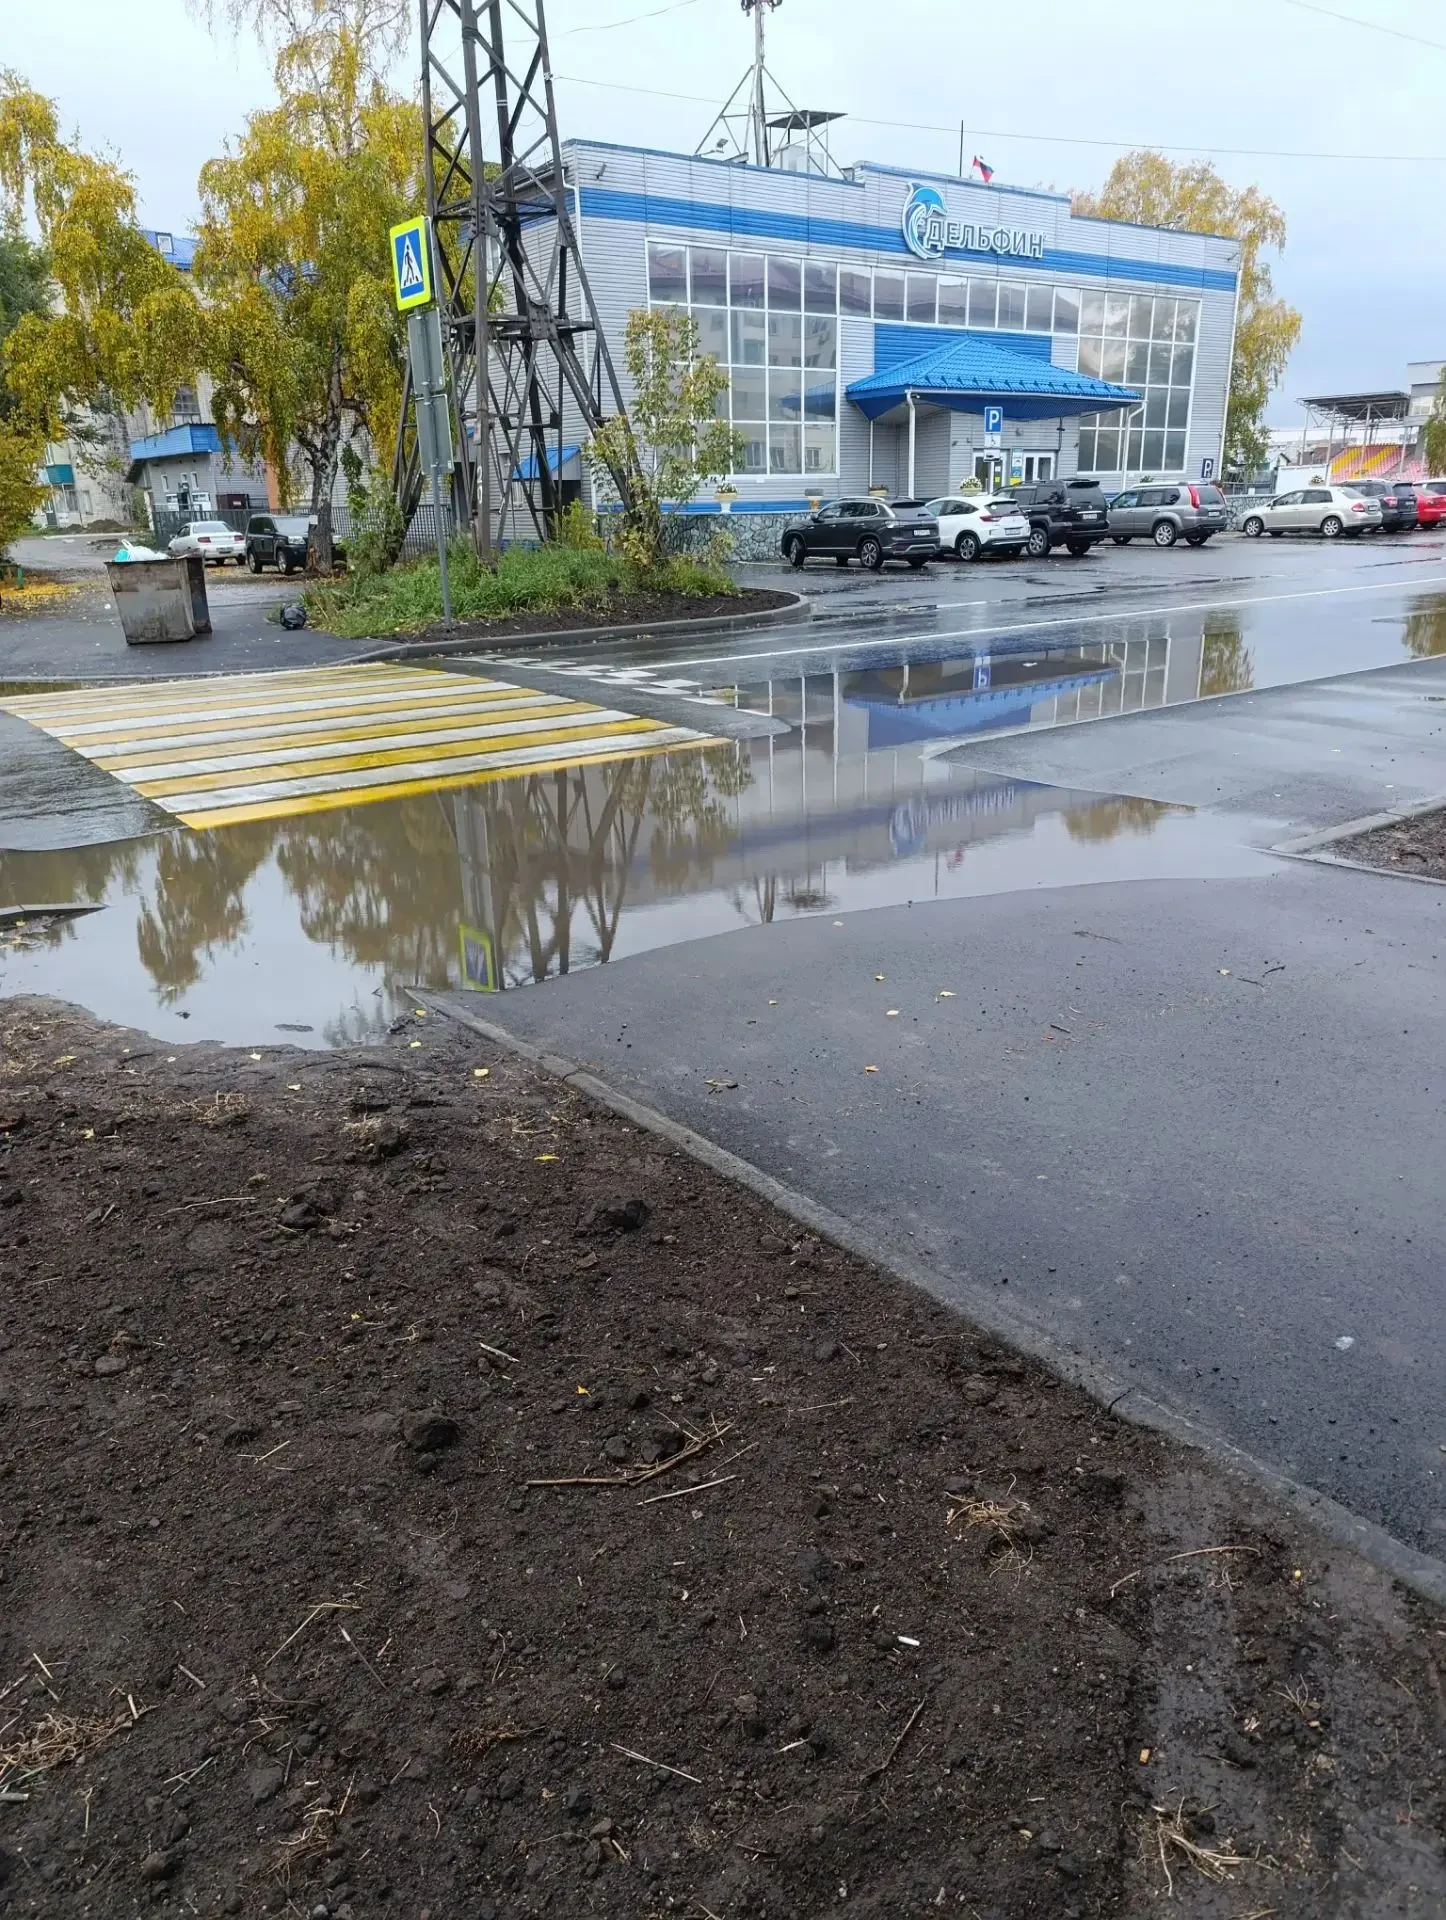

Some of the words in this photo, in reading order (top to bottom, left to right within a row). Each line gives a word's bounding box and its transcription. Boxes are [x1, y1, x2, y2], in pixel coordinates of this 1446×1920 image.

[924, 218, 1044, 258] ДЕЛЬФИН
[989, 410, 999, 430] P
[1203, 460, 1212, 478] P
